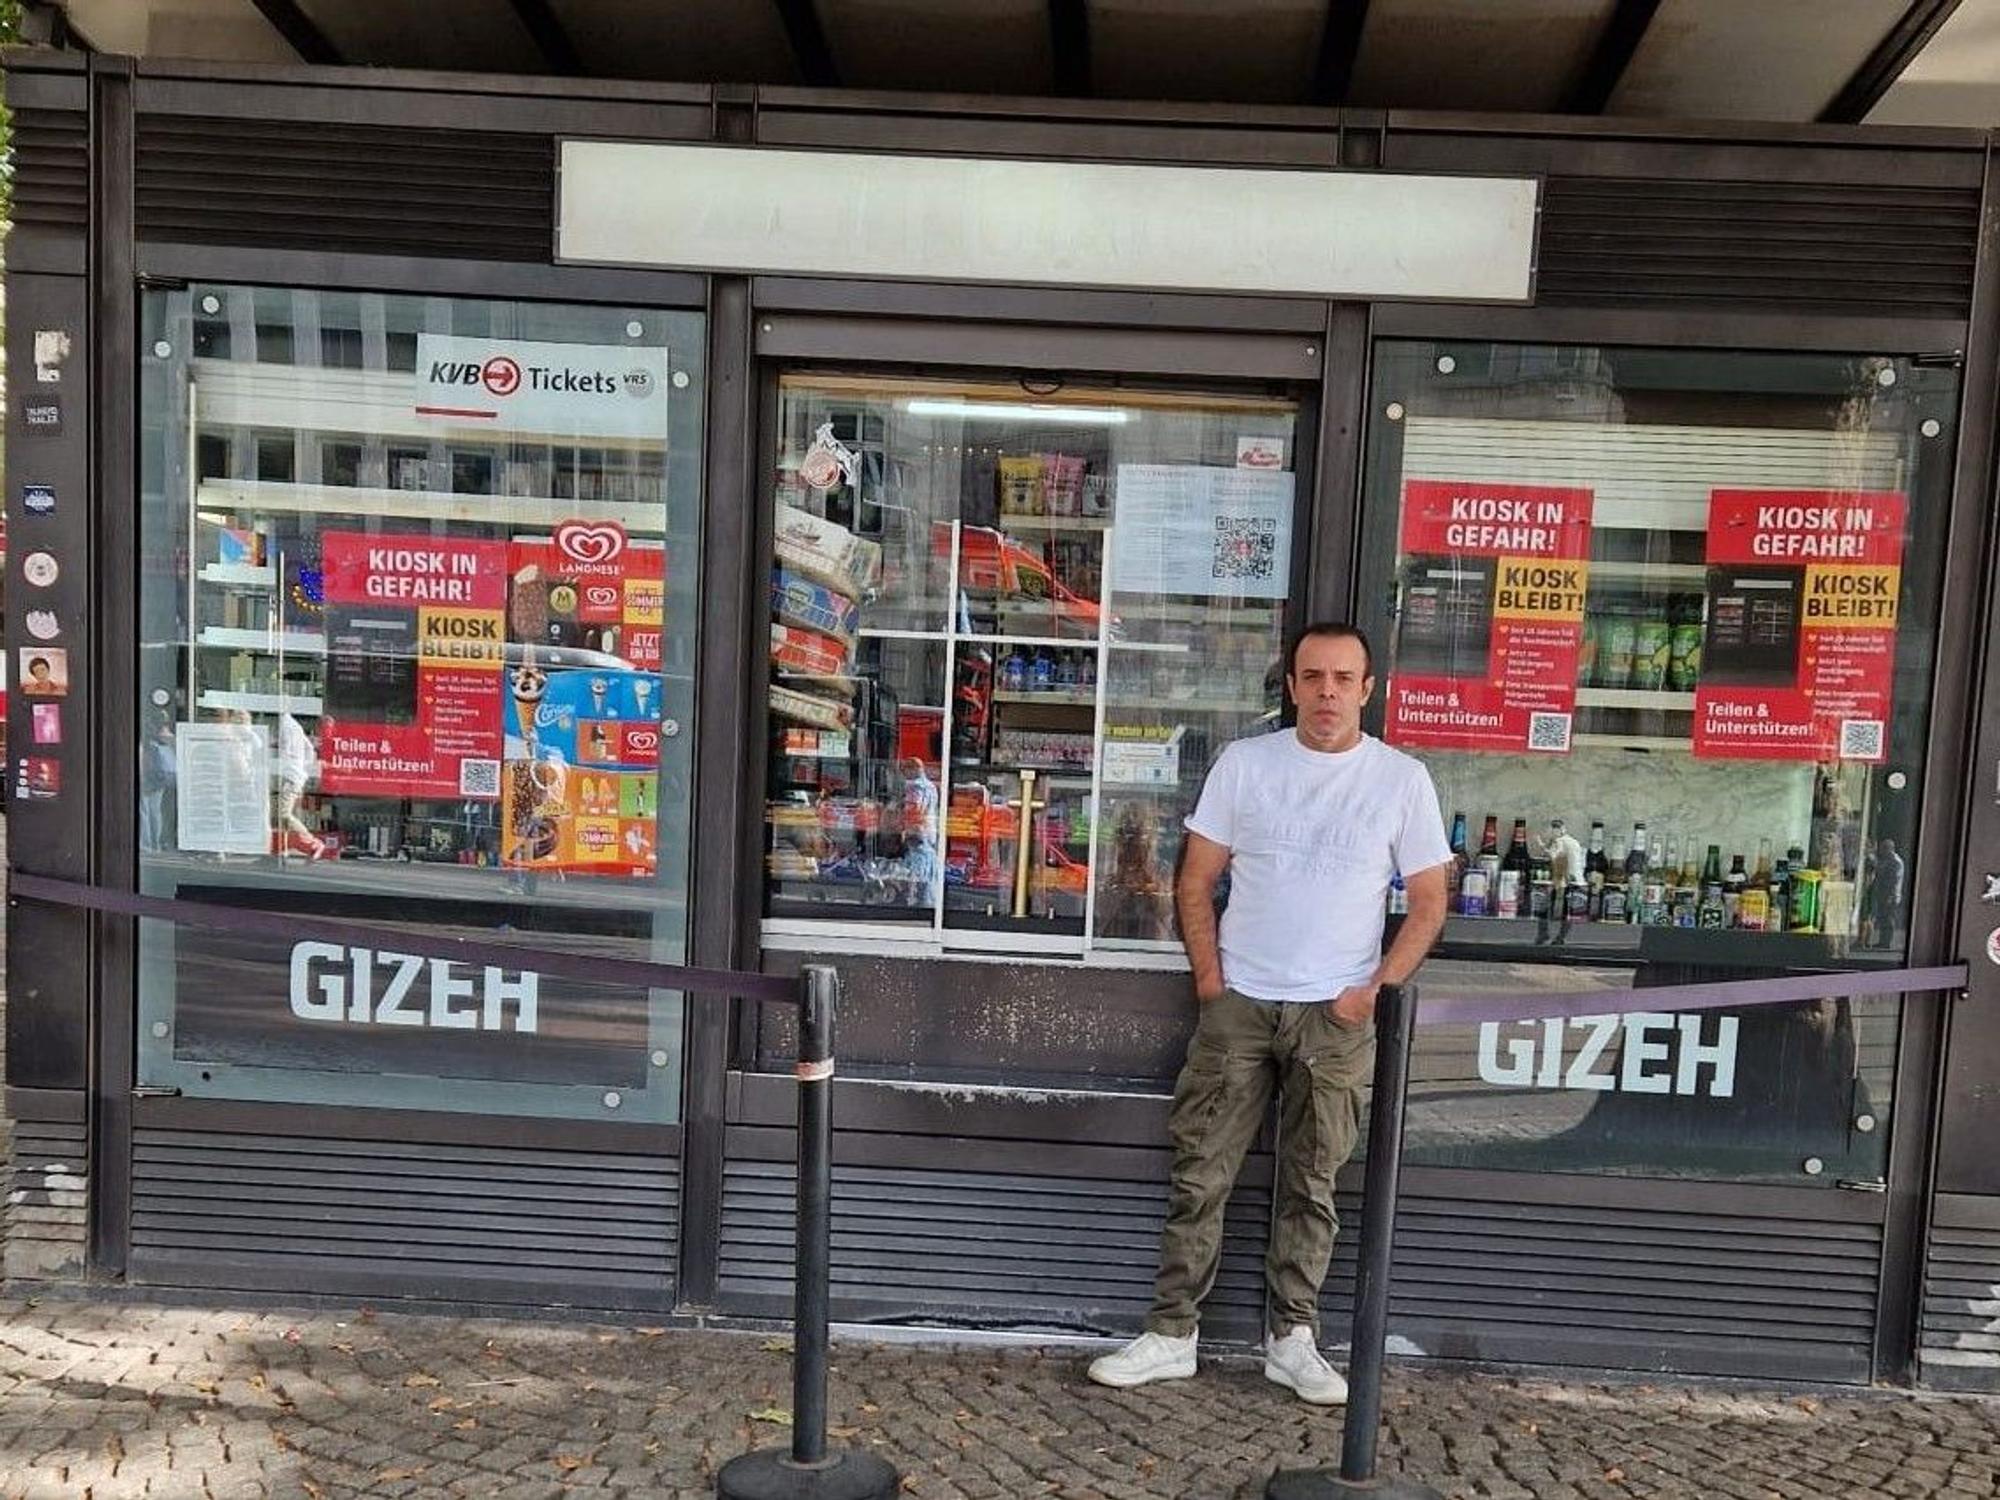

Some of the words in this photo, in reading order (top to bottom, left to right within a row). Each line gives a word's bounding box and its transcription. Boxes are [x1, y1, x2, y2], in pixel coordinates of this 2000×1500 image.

[429, 360, 481, 386] KVB
[528, 367, 616, 393] Tickets
[1452, 498, 1529, 523] KIOSK
[1536, 502, 1563, 524] IN
[1758, 506, 1838, 530] KIOSK
[1845, 508, 1873, 530] IN
[1447, 524, 1556, 550] GEFAHR!
[1753, 533, 1865, 557] GEFAHR!
[369, 548, 445, 573] KIOSK
[451, 553, 476, 575] IN
[366, 575, 471, 601] GEFAHR!
[1505, 566, 1578, 589] KIOSK
[1813, 574, 1889, 596] KIOSK
[1499, 589, 1584, 613] BLEIBT!
[1806, 597, 1894, 620] BLEIBT!
[427, 615, 497, 639] KIOSK
[422, 640, 503, 660] BLEIBT!
[1400, 689, 1444, 706] Teilen
[1448, 693, 1459, 707] &
[1706, 701, 1753, 717] Teilen
[1757, 703, 1769, 717] &
[1398, 706, 1504, 727] Unterstützen!
[1705, 718, 1814, 736] Unterstützen!
[333, 737, 376, 753] Teilen
[380, 740, 391, 754] &
[332, 754, 434, 773] Unterstützen!
[290, 940, 539, 1033] GIZEH
[1477, 1011, 1740, 1098] GIZEH
